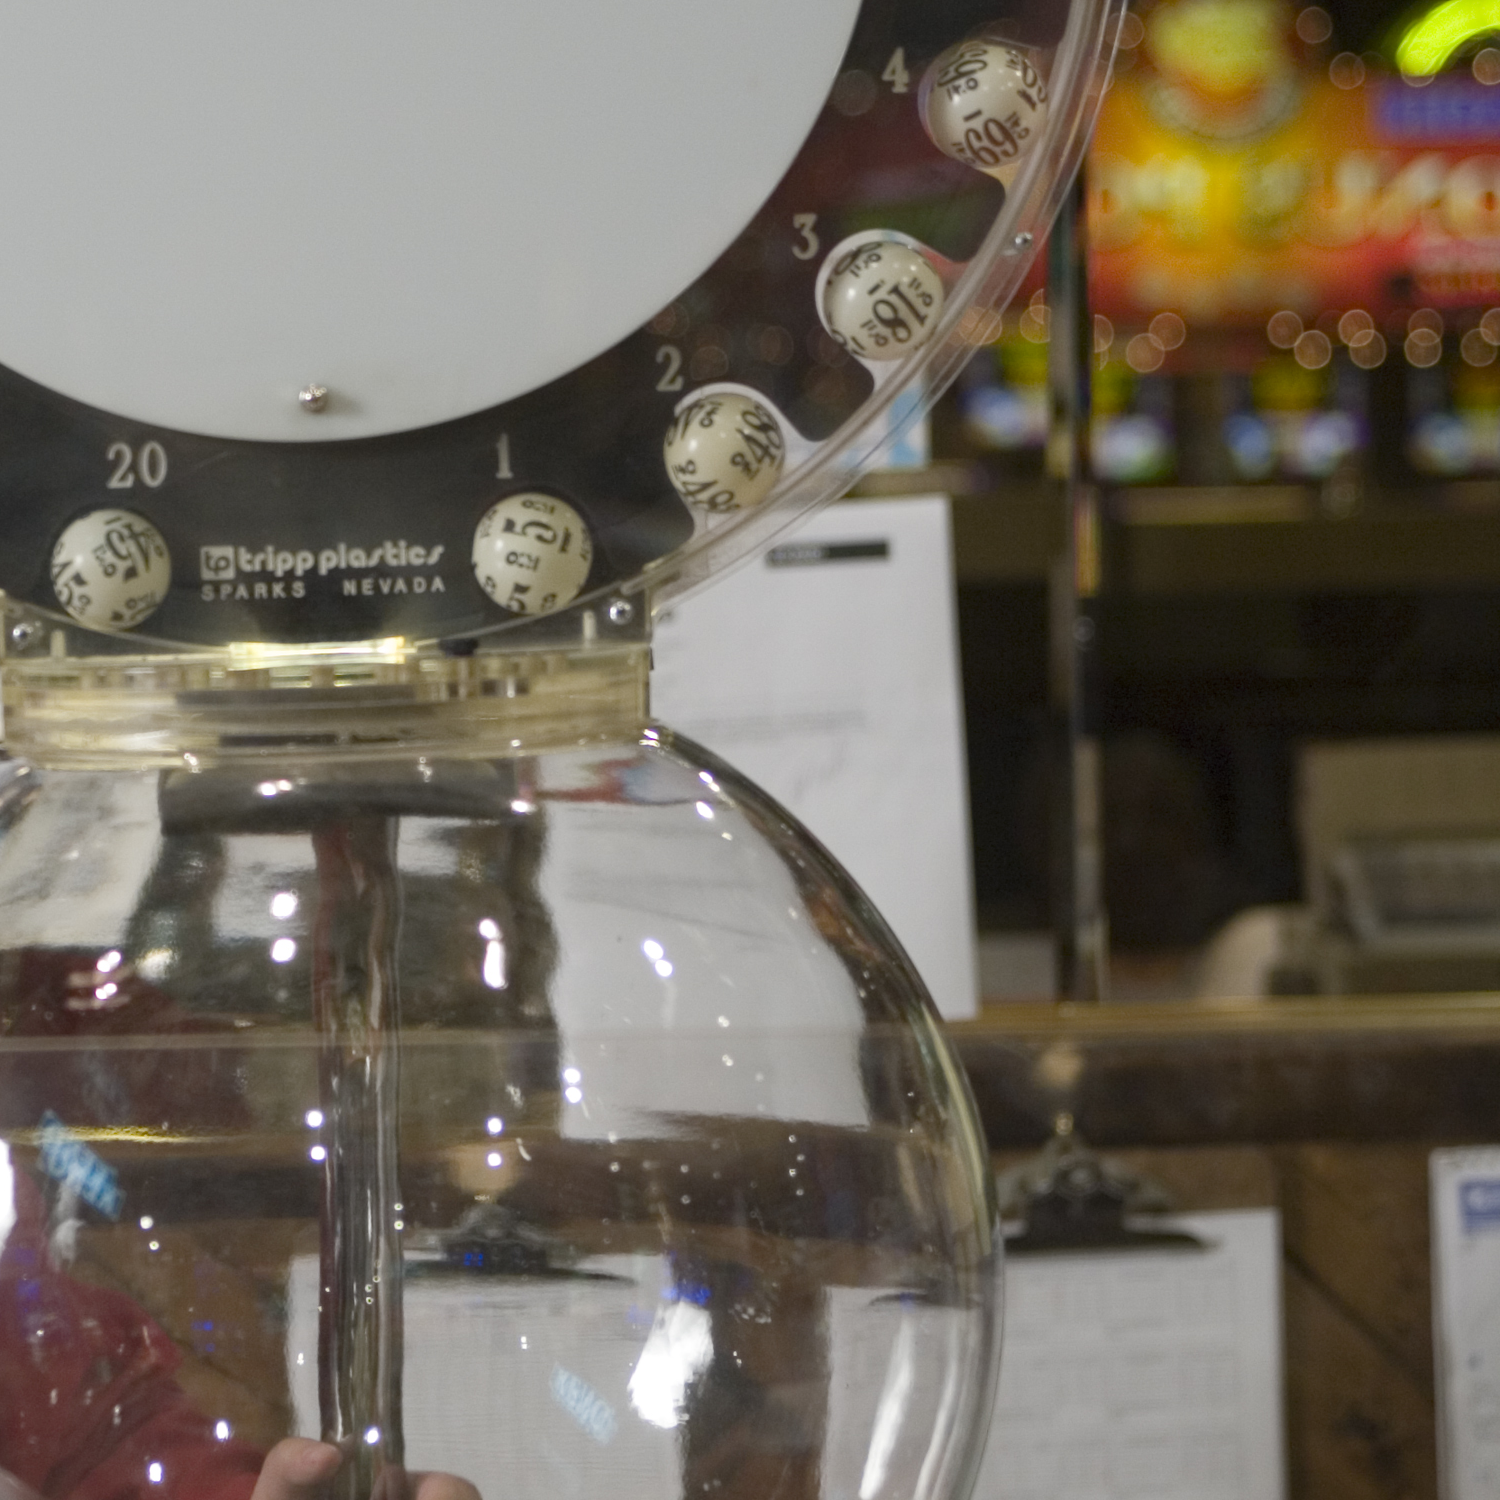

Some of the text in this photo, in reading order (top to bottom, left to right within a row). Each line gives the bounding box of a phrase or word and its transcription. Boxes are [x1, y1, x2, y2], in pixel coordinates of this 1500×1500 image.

[883, 48, 909, 94] 4
[792, 214, 818, 260] 3
[657, 346, 683, 391] 2
[108, 442, 168, 489] 20
[496, 434, 513, 480] 1
[238, 544, 315, 577] tripp
[318, 539, 445, 576] plastics
[201, 576, 446, 601] SPARKS NEVADA
